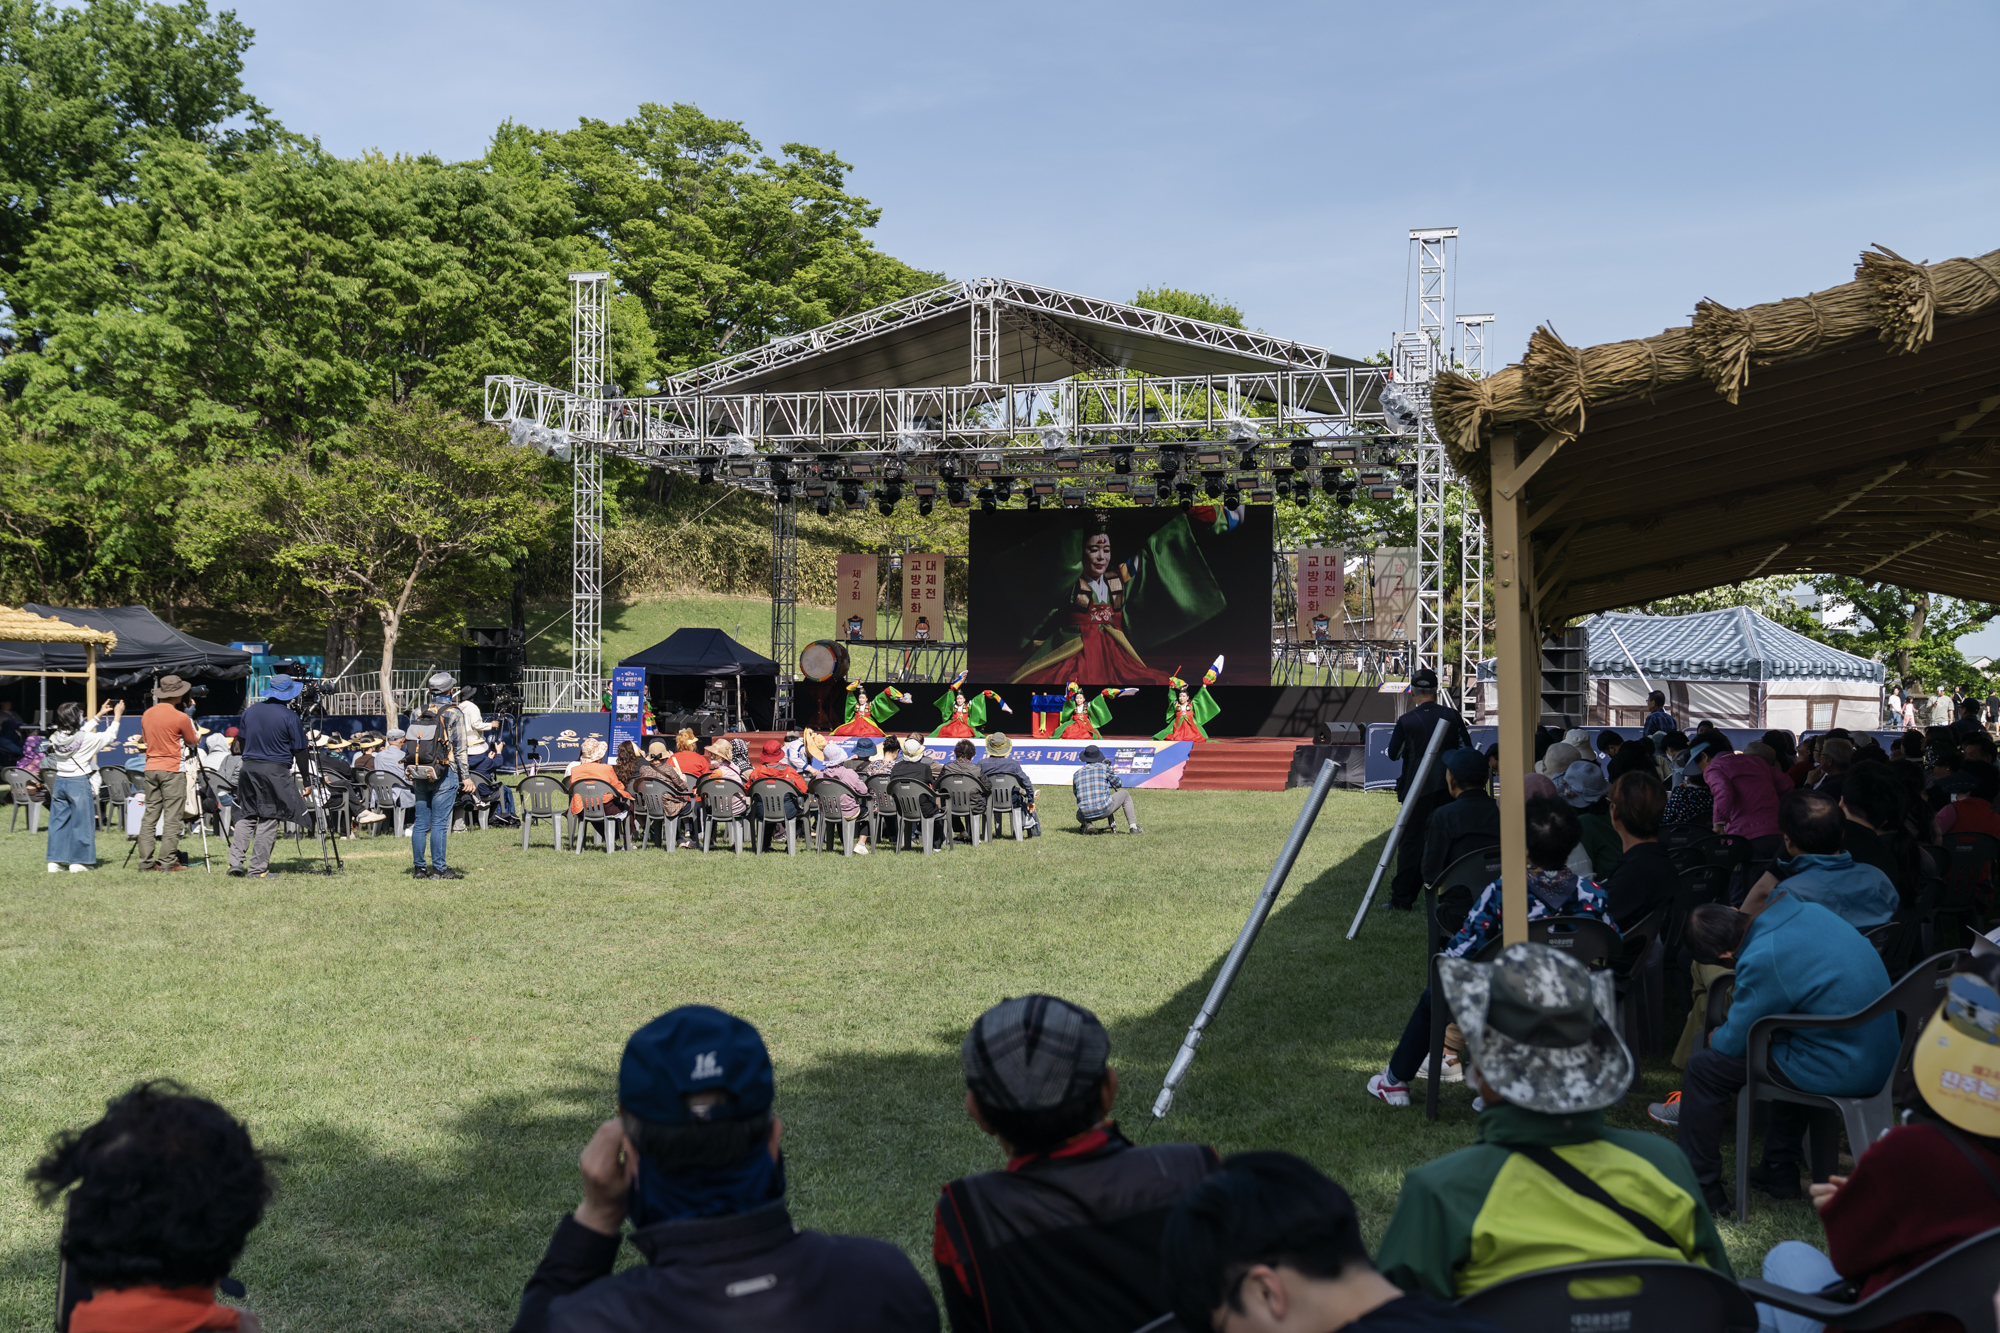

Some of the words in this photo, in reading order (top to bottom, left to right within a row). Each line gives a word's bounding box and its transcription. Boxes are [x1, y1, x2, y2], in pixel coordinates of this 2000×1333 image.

[851, 569, 861, 600] 제2회
[910, 560, 922, 613] 교방문화
[925, 560, 936, 599] 대제전
[1307, 556, 1320, 612] 교방문화
[1324, 555, 1336, 597] 대제전
[1393, 563, 1404, 597] 제2회
[1046, 750, 1081, 762] 대제
